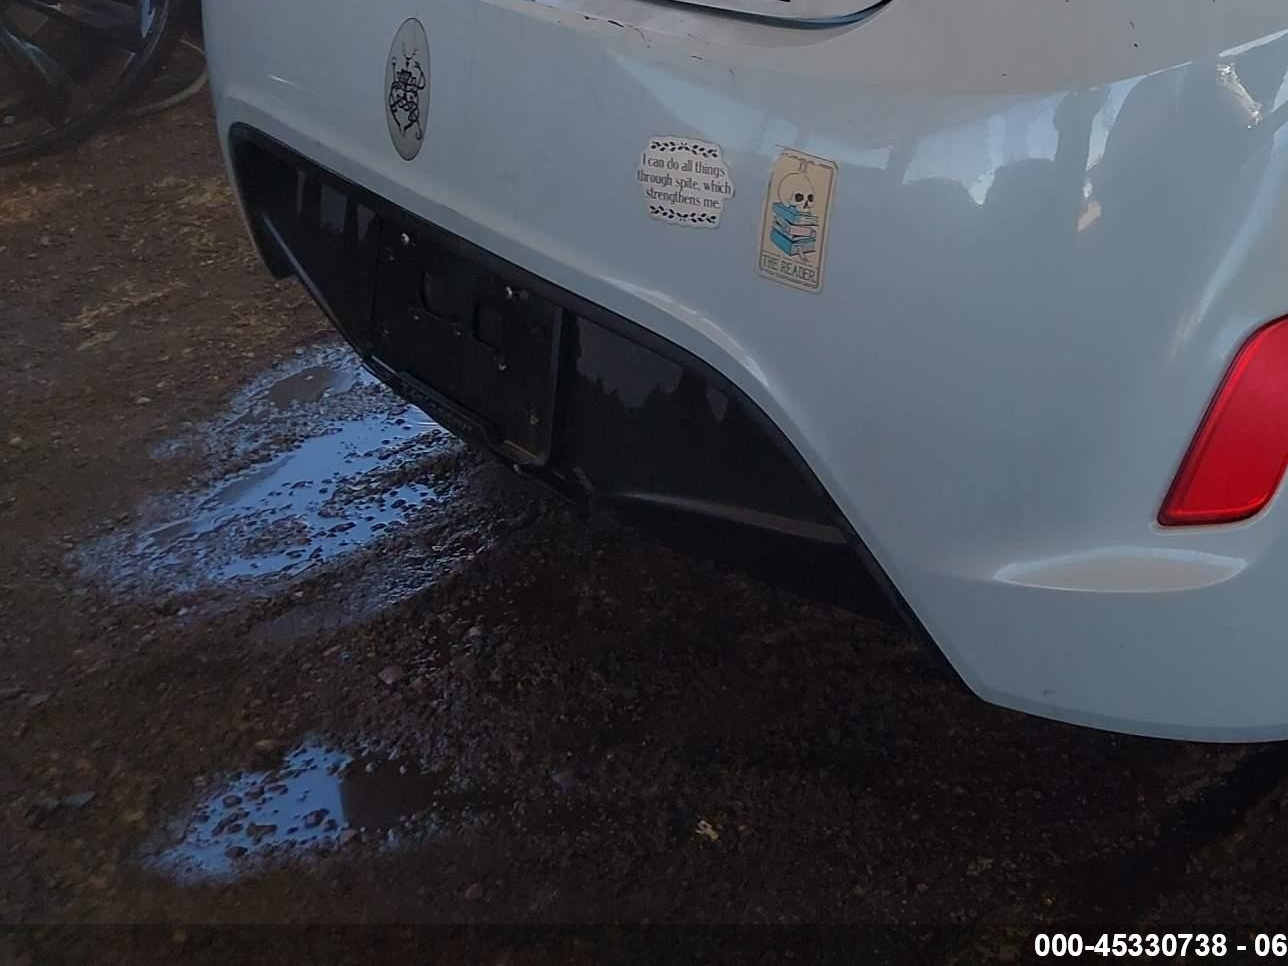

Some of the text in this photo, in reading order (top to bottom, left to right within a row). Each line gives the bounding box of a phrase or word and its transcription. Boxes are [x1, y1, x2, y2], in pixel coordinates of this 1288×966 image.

[648, 157, 665, 168] can
[667, 157, 679, 170] do
[681, 160, 693, 172] all
[695, 161, 726, 178] things
[637, 169, 673, 187] through
[703, 180, 731, 195] which
[646, 187, 721, 209] strengthens me.
[762, 254, 818, 283] THE READER
